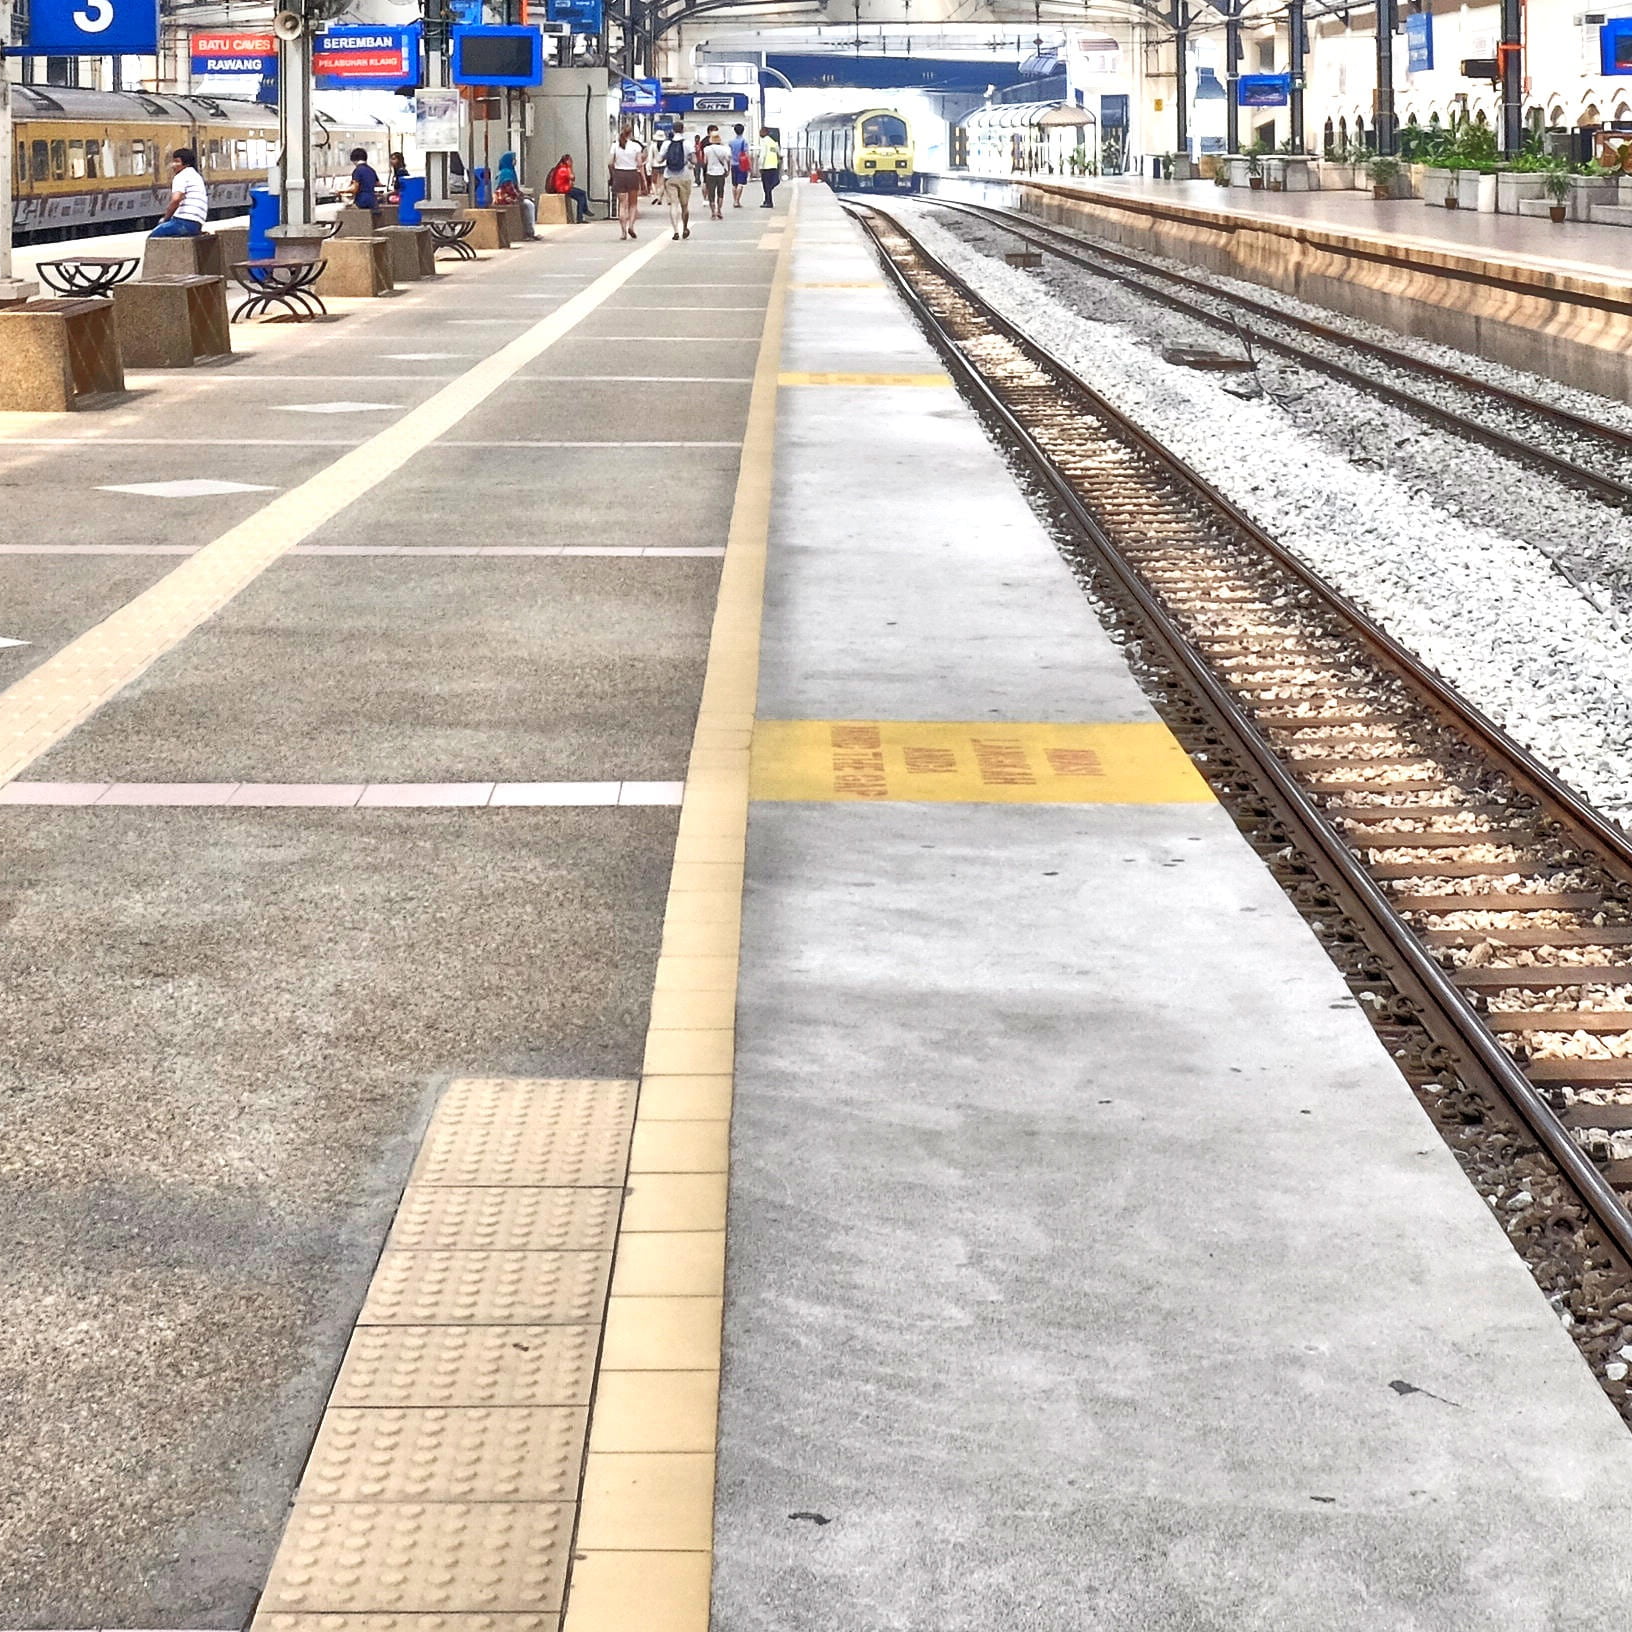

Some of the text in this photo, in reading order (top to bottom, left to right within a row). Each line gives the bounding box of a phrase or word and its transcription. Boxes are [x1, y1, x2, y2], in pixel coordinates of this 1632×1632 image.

[198, 39, 271, 51] BATU CAVES
[323, 36, 393, 49] SEREMBAN
[207, 59, 262, 71] RAWANG
[369, 57, 398, 67] KLANG
[832, 751, 885, 772] THE
[904, 747, 958, 774] ANDA
[970, 737, 1037, 785] LANGKAH
[833, 775, 889, 797] GAP
